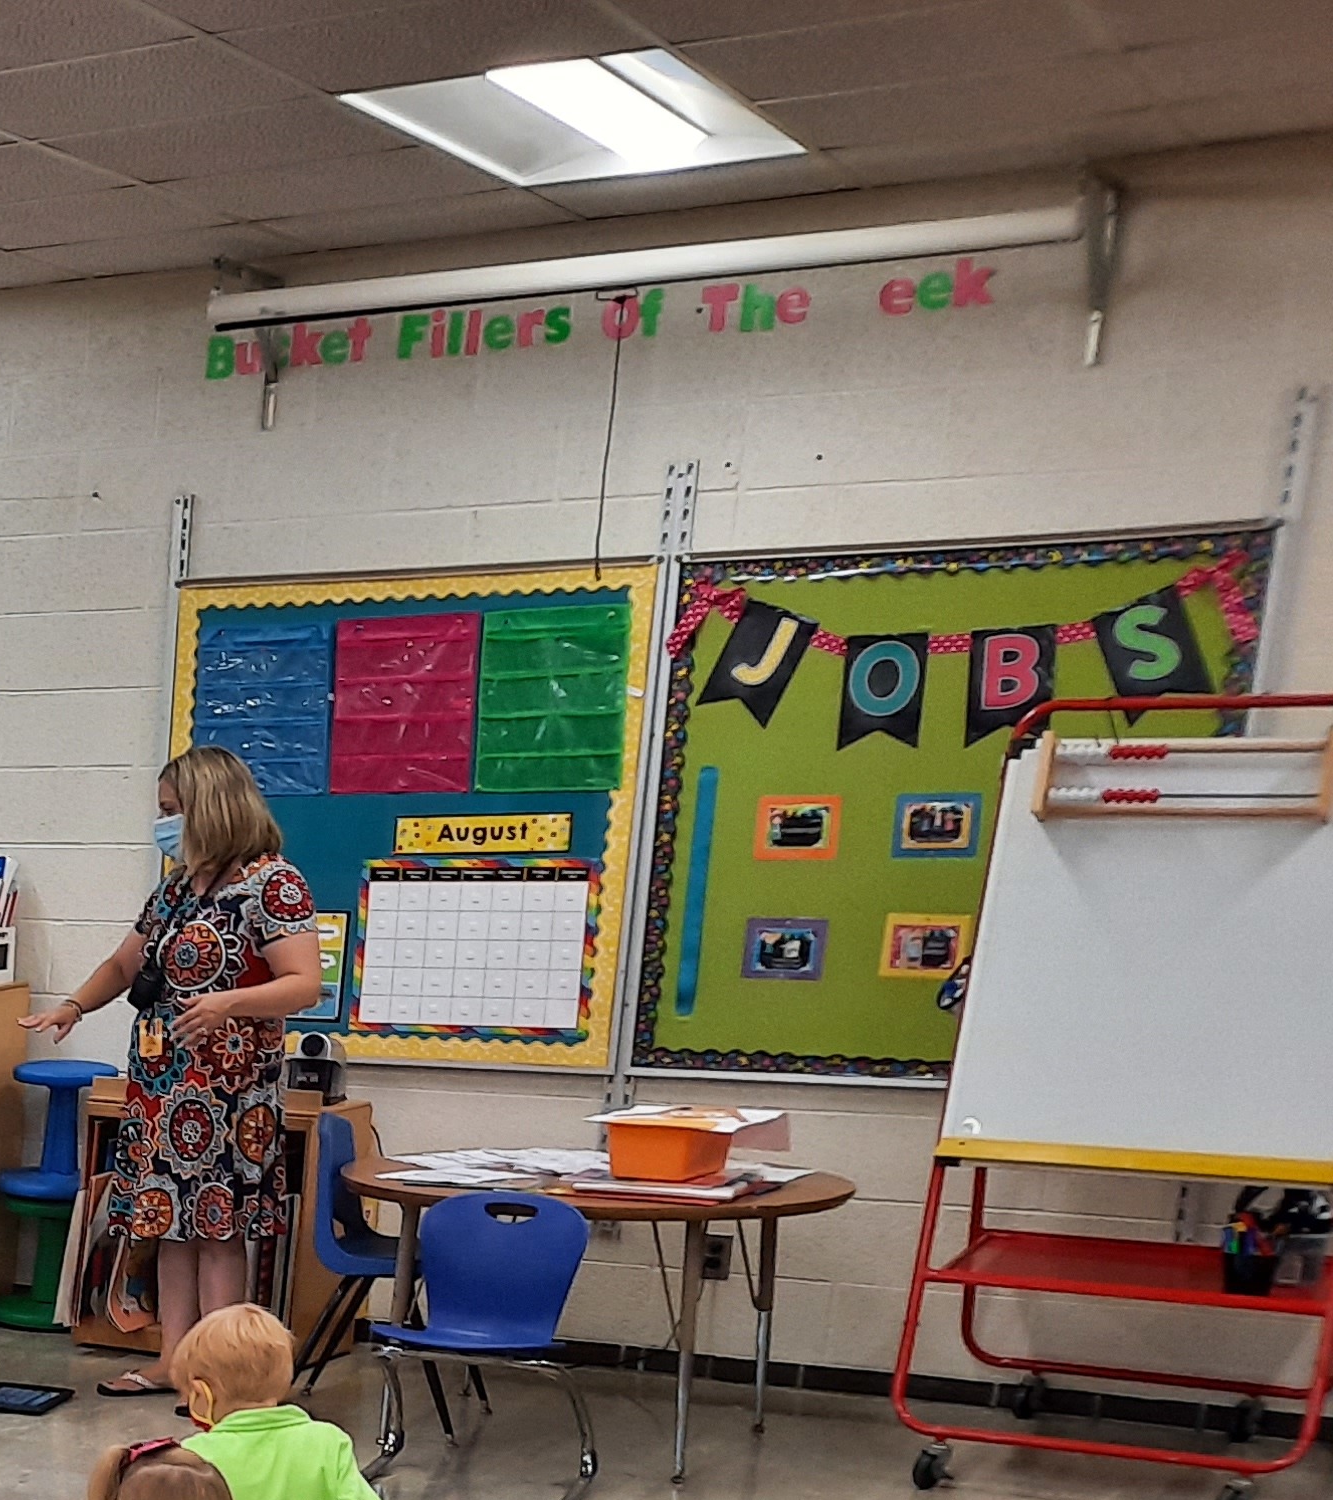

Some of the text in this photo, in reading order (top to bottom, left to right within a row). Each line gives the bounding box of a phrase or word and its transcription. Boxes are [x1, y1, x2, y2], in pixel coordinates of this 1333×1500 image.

[397, 306, 572, 360] Fillers
[601, 287, 664, 340] Of
[702, 283, 812, 333] The
[731, 604, 1182, 717] JOBS
[437, 822, 529, 845] August
